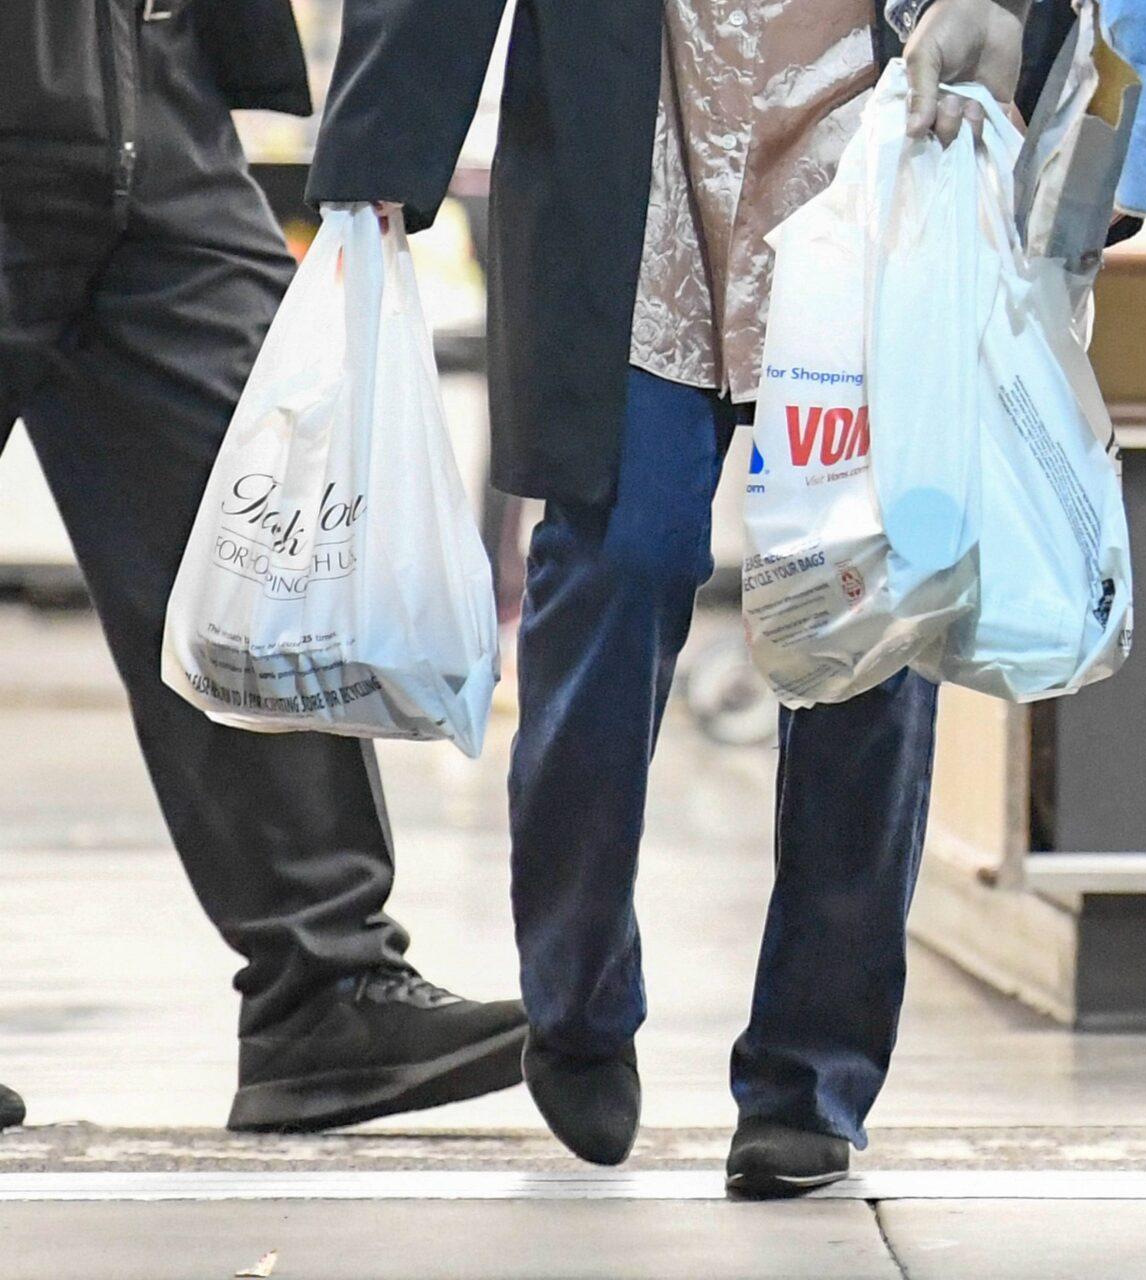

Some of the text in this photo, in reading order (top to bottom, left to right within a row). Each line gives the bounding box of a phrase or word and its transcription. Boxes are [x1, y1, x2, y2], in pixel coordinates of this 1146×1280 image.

[766, 365, 864, 386] for Shopping
[773, 561, 799, 580] YOUR
[797, 551, 825, 572] BAGS
